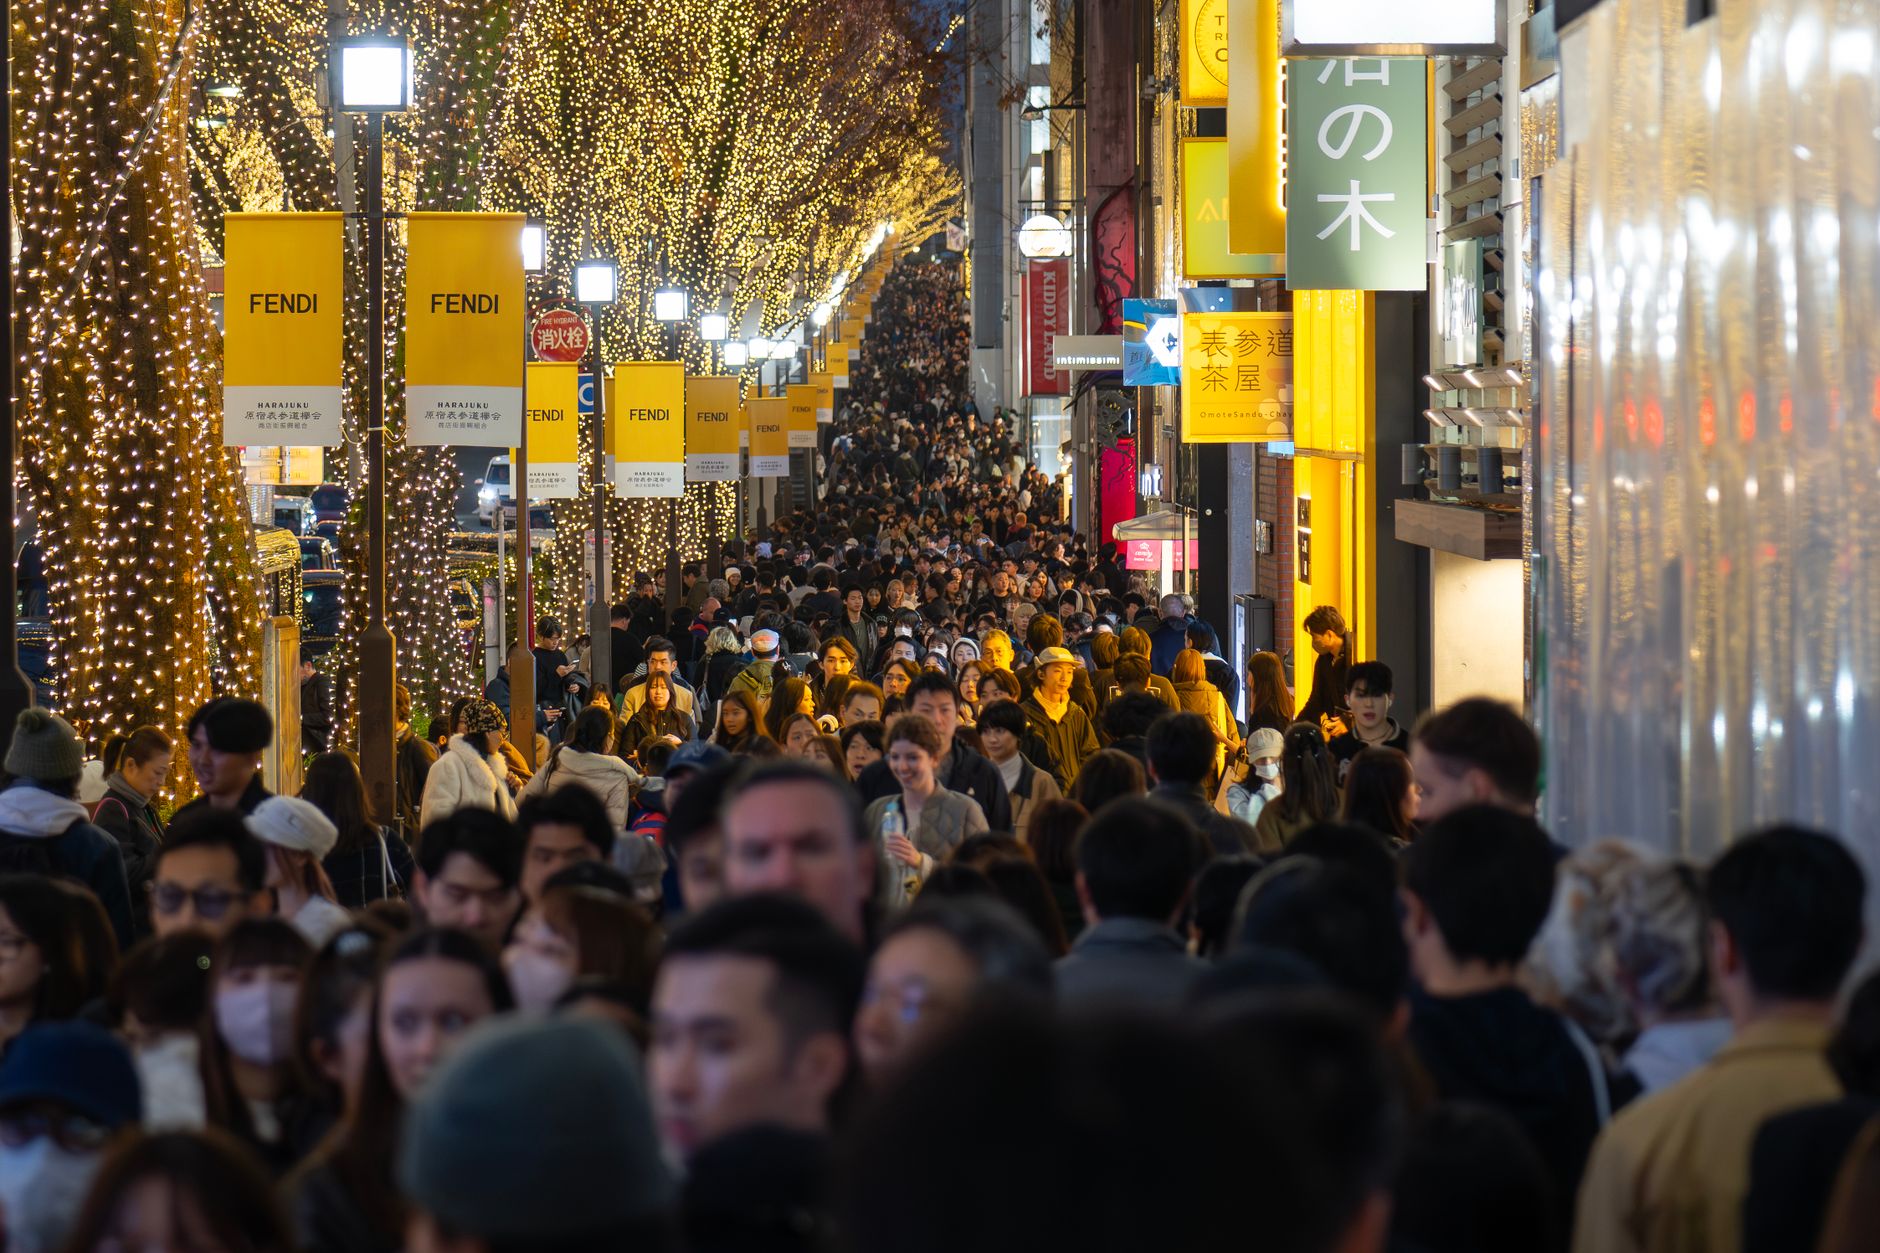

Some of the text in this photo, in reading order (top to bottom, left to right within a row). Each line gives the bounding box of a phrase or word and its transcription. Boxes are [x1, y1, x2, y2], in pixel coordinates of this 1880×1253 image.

[249, 293, 318, 314] FENDI
[430, 293, 499, 315] FENDI
[1043, 271, 1057, 327] KIDDY
[537, 326, 584, 351] 消火栓
[1200, 329, 1294, 358] 表参道
[1200, 363, 1262, 392] 茶屋
[527, 409, 564, 421] FENDI
[629, 409, 670, 421] FENDI
[697, 412, 729, 422] FENDI
[756, 424, 781, 433] FENDI
